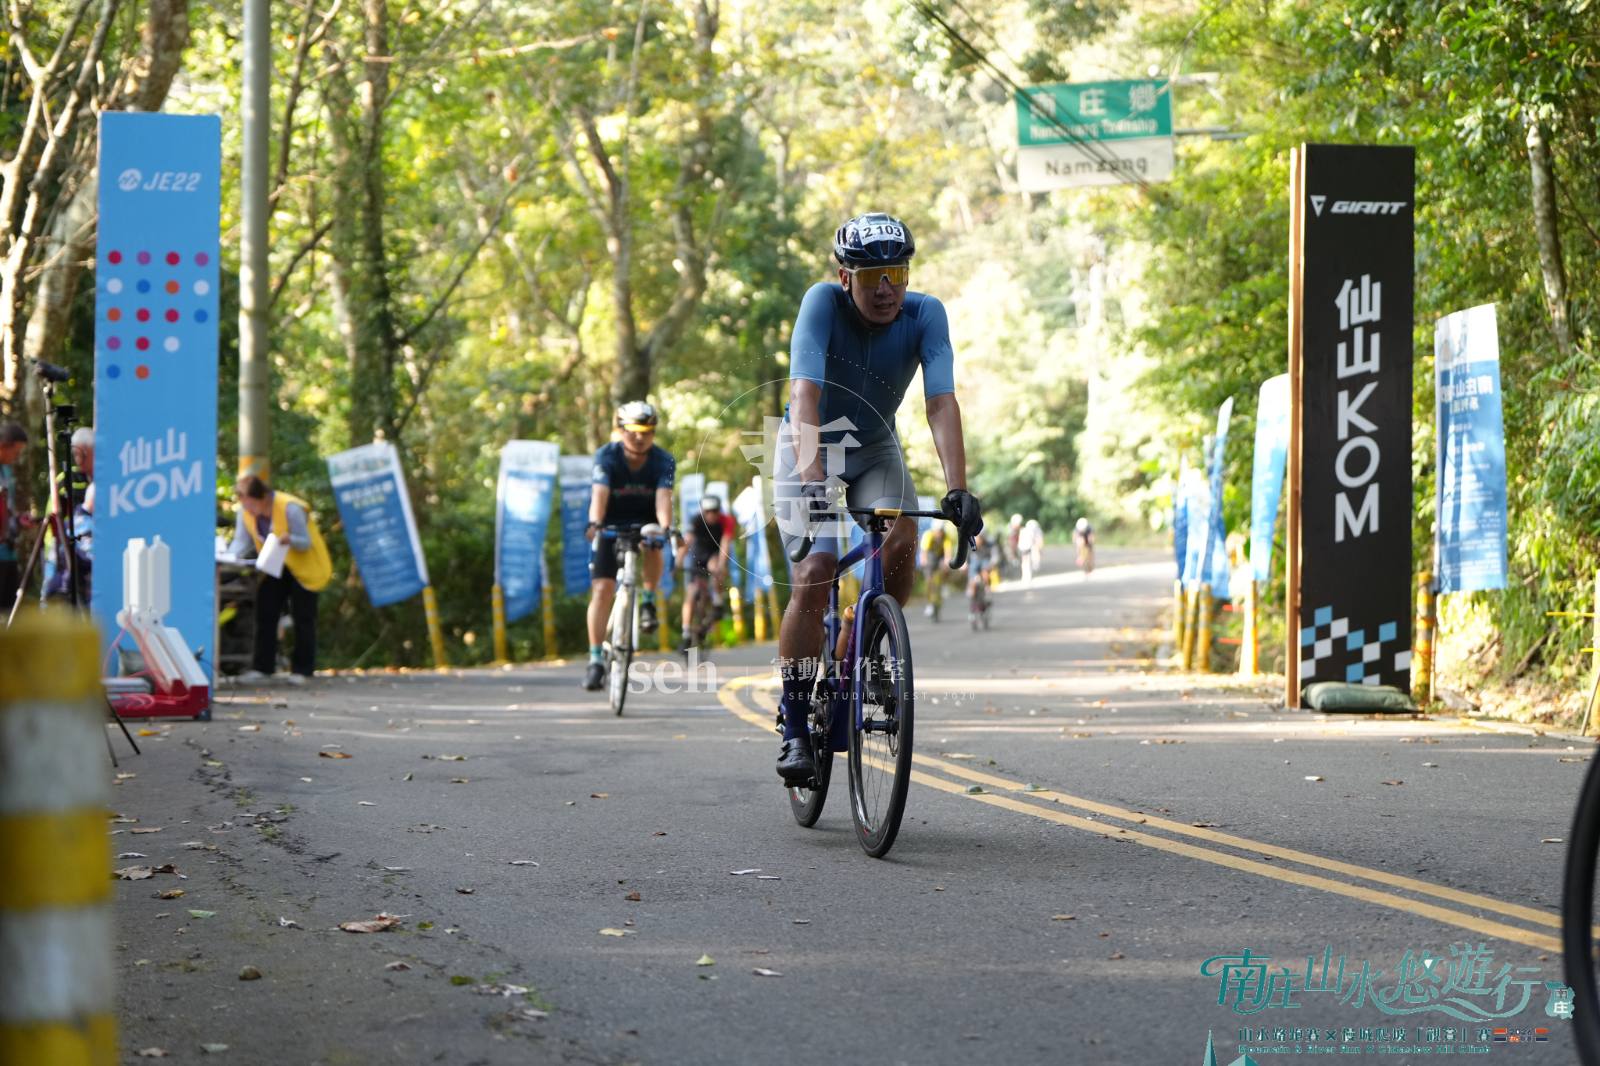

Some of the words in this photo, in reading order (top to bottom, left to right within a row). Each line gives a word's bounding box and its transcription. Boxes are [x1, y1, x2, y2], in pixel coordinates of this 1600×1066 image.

[143, 171, 202, 192] JE22
[1330, 200, 1408, 215] GIANT
[118, 428, 187, 477] 仙山
[109, 460, 203, 518] KOM
